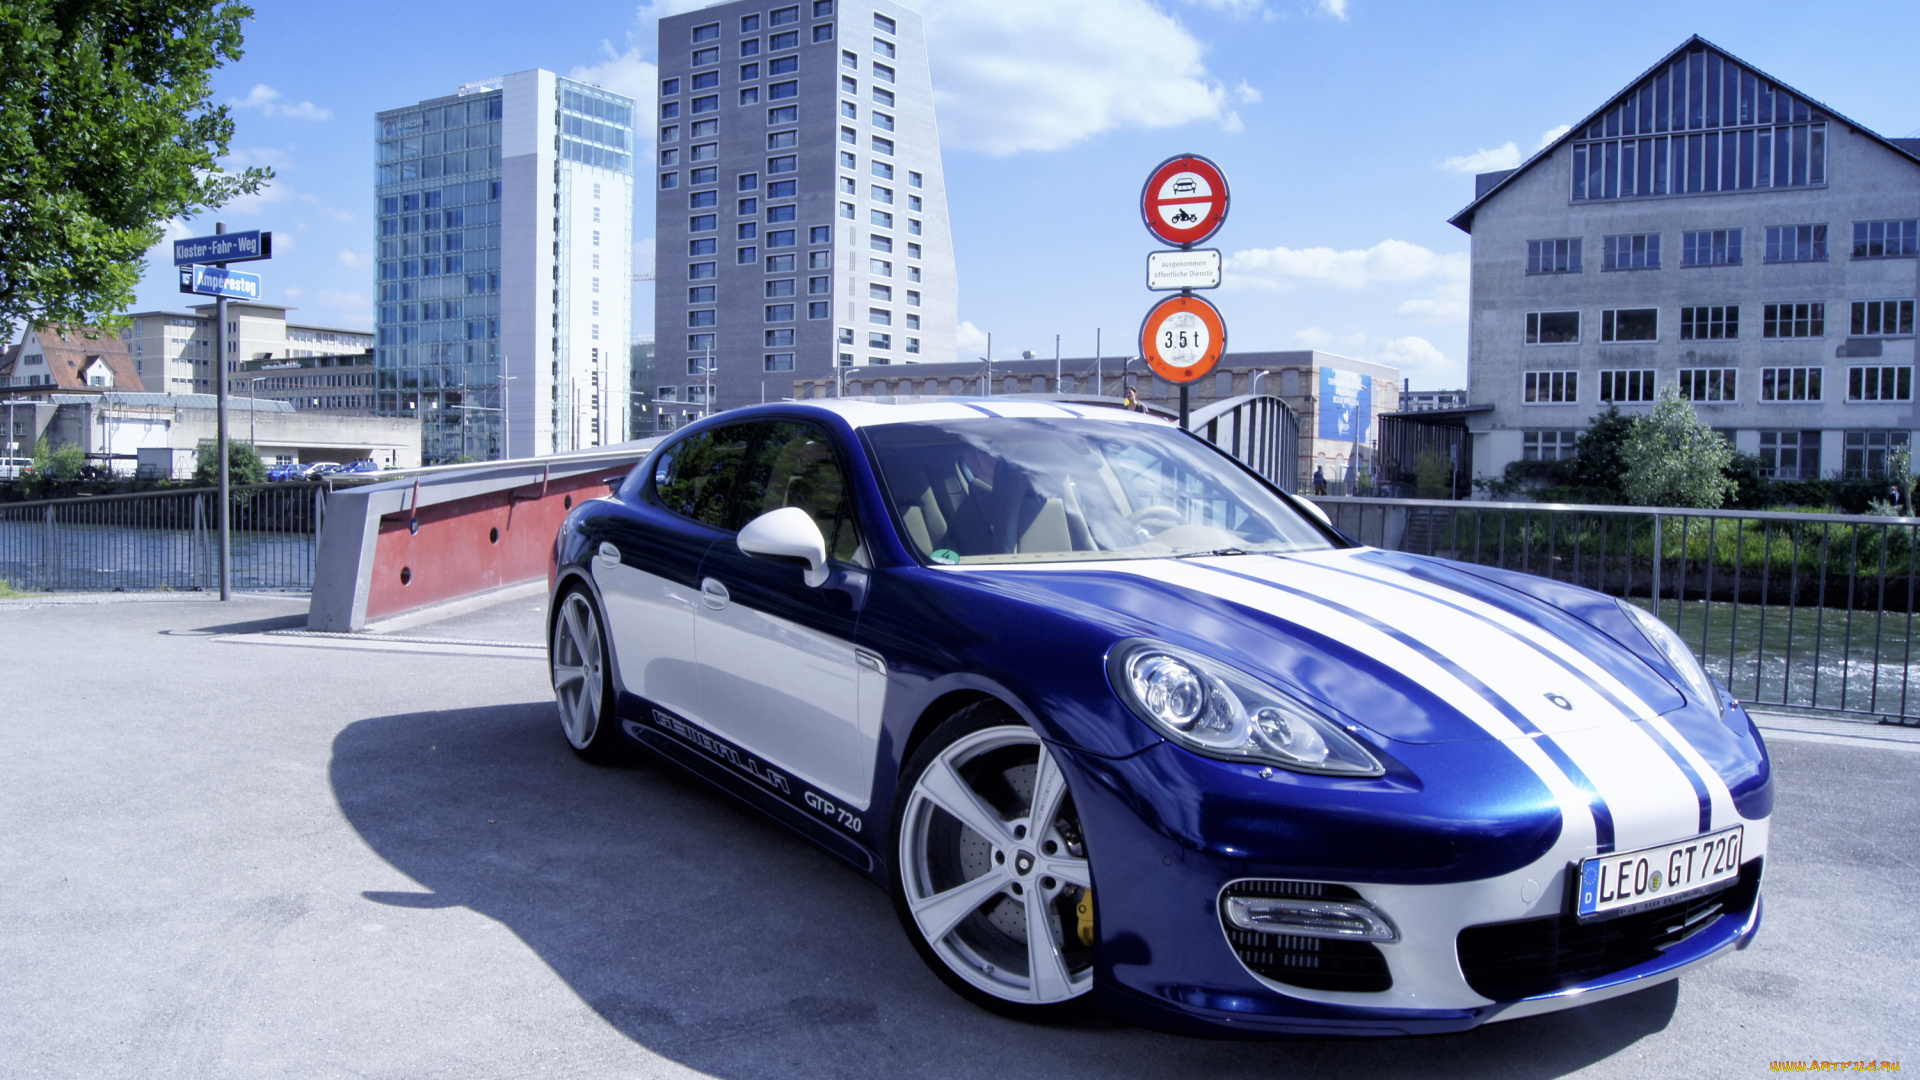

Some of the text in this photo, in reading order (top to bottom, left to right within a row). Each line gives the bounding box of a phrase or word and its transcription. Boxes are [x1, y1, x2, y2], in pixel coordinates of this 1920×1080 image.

[176, 237, 257, 259] Kloster-Fahr-Weg
[1161, 260, 1207, 268] ausgenommen
[1154, 270, 1188, 278] öffentliche
[197, 271, 257, 297] Ampèresteg
[941, 550, 950, 560] 4
[652, 708, 862, 833] GEMBALLA GTP 720
[1600, 858, 1649, 903] LEO
[1668, 845, 1697, 887] GT
[1701, 834, 1738, 879] 720
[1585, 892, 1592, 905] D
